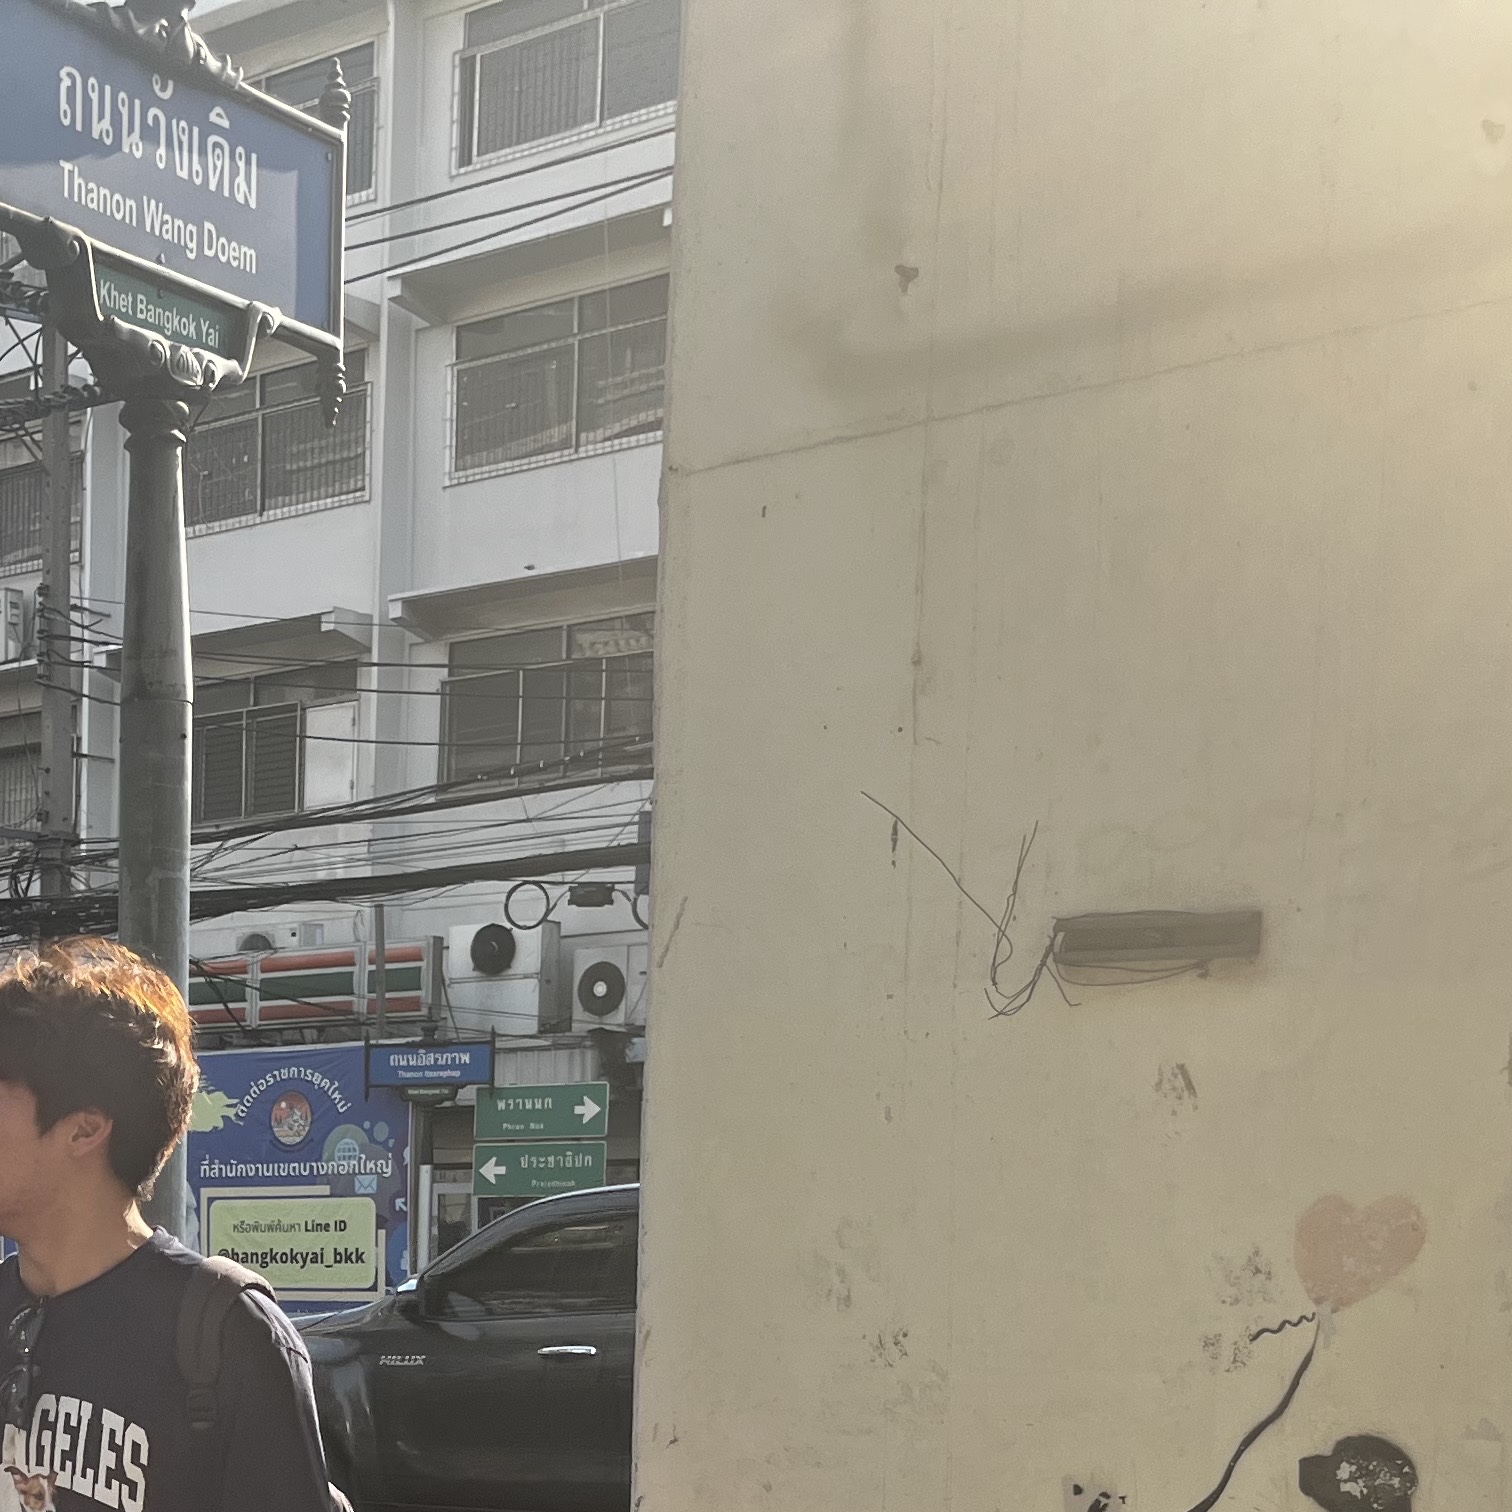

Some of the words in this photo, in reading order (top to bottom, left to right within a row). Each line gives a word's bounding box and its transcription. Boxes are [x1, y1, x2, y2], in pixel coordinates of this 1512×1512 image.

[59, 65, 257, 210] ถนนวังเดิม
[59, 160, 138, 228] Thanon
[143, 195, 198, 261] Wang
[203, 221, 257, 275] Doem
[99, 279, 133, 316] Khet
[136, 293, 197, 341] Bangkok
[200, 317, 220, 349] Yai
[389, 1049, 470, 1067] ถนนอิสรภาพ
[304, 1219, 331, 1233] Line
[334, 1219, 347, 1233] ID
[379, 1354, 427, 1366] HILUX
